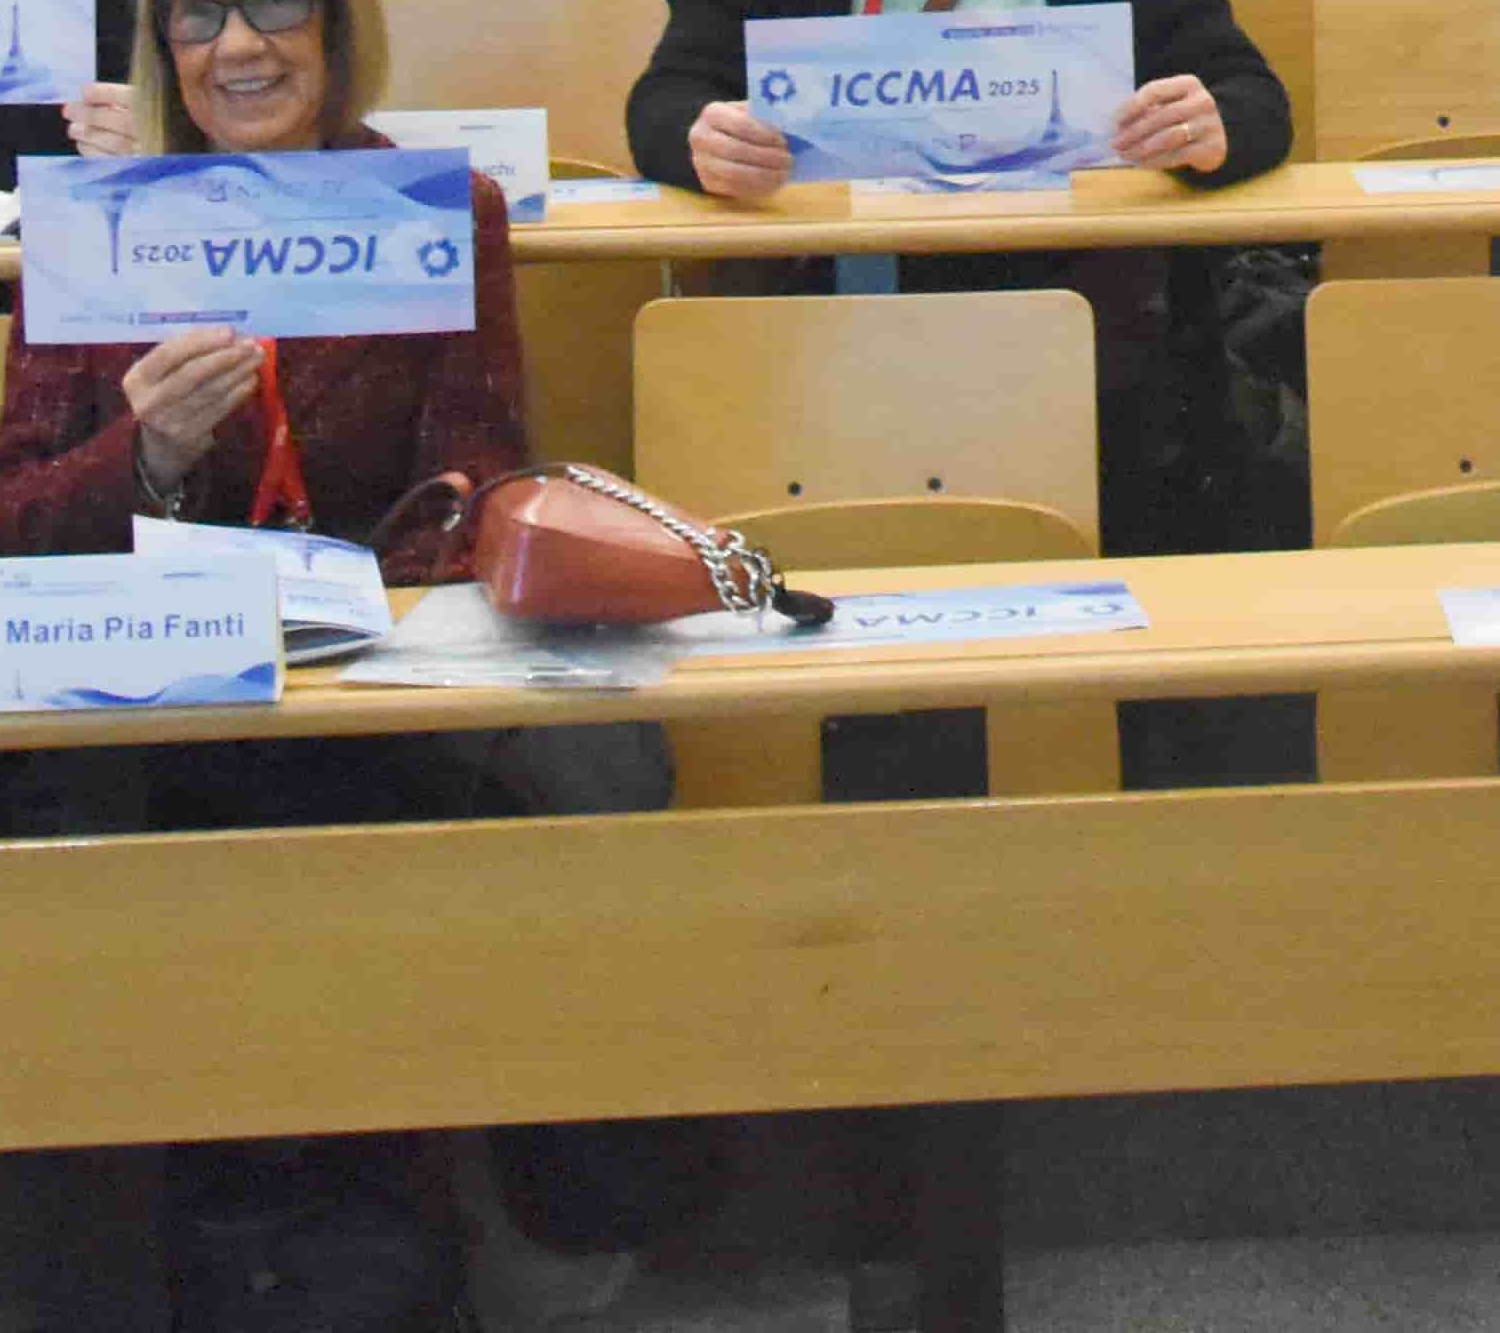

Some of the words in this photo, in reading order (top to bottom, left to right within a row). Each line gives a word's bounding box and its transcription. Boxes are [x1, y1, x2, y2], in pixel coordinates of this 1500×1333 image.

[828, 66, 982, 109] ICCMA
[987, 76, 1042, 100] 2025
[131, 243, 195, 267] 2025
[203, 234, 377, 279] ICCMA
[6, 618, 94, 644] Maria
[104, 615, 153, 641] Pia
[164, 612, 244, 638] Fanti
[853, 603, 1040, 628] ICCMA
